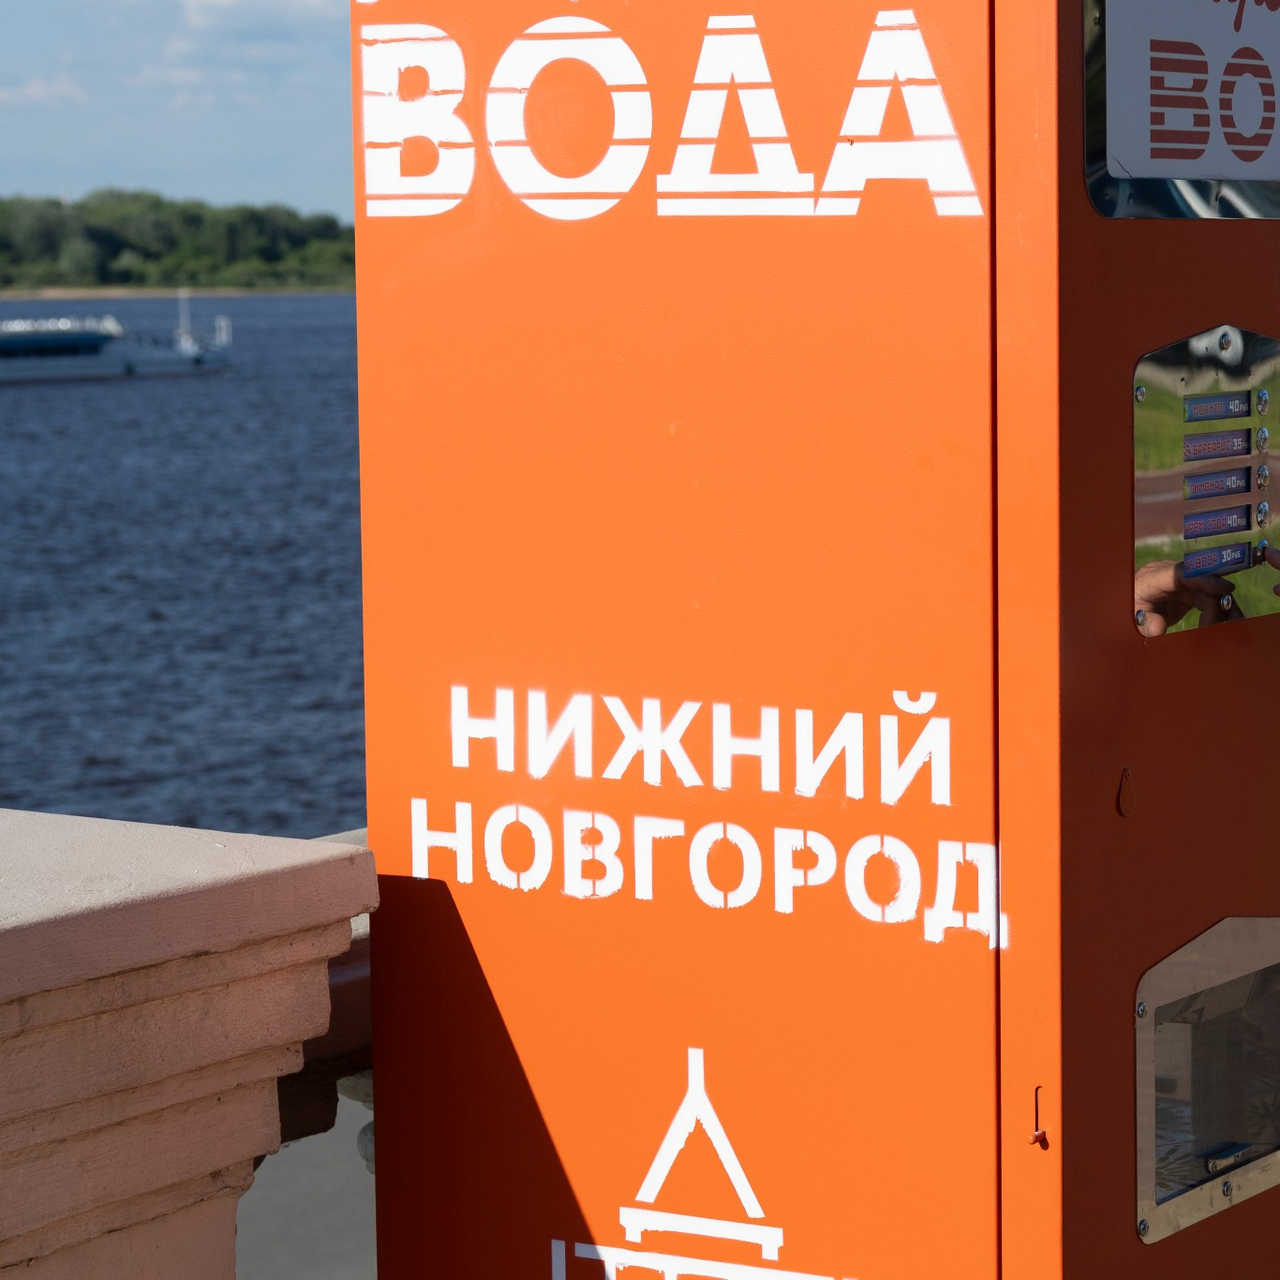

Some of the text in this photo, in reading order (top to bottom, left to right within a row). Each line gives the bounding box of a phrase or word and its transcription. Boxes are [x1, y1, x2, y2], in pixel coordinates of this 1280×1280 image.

[359, 9, 984, 220] ВОДА
[1189, 478, 1225, 493] ЛИМОНАД
[1206, 517, 1227, 532] СОДА
[450, 684, 952, 807] НИЖНИЙ
[410, 797, 1010, 950] НОВГОРОД
